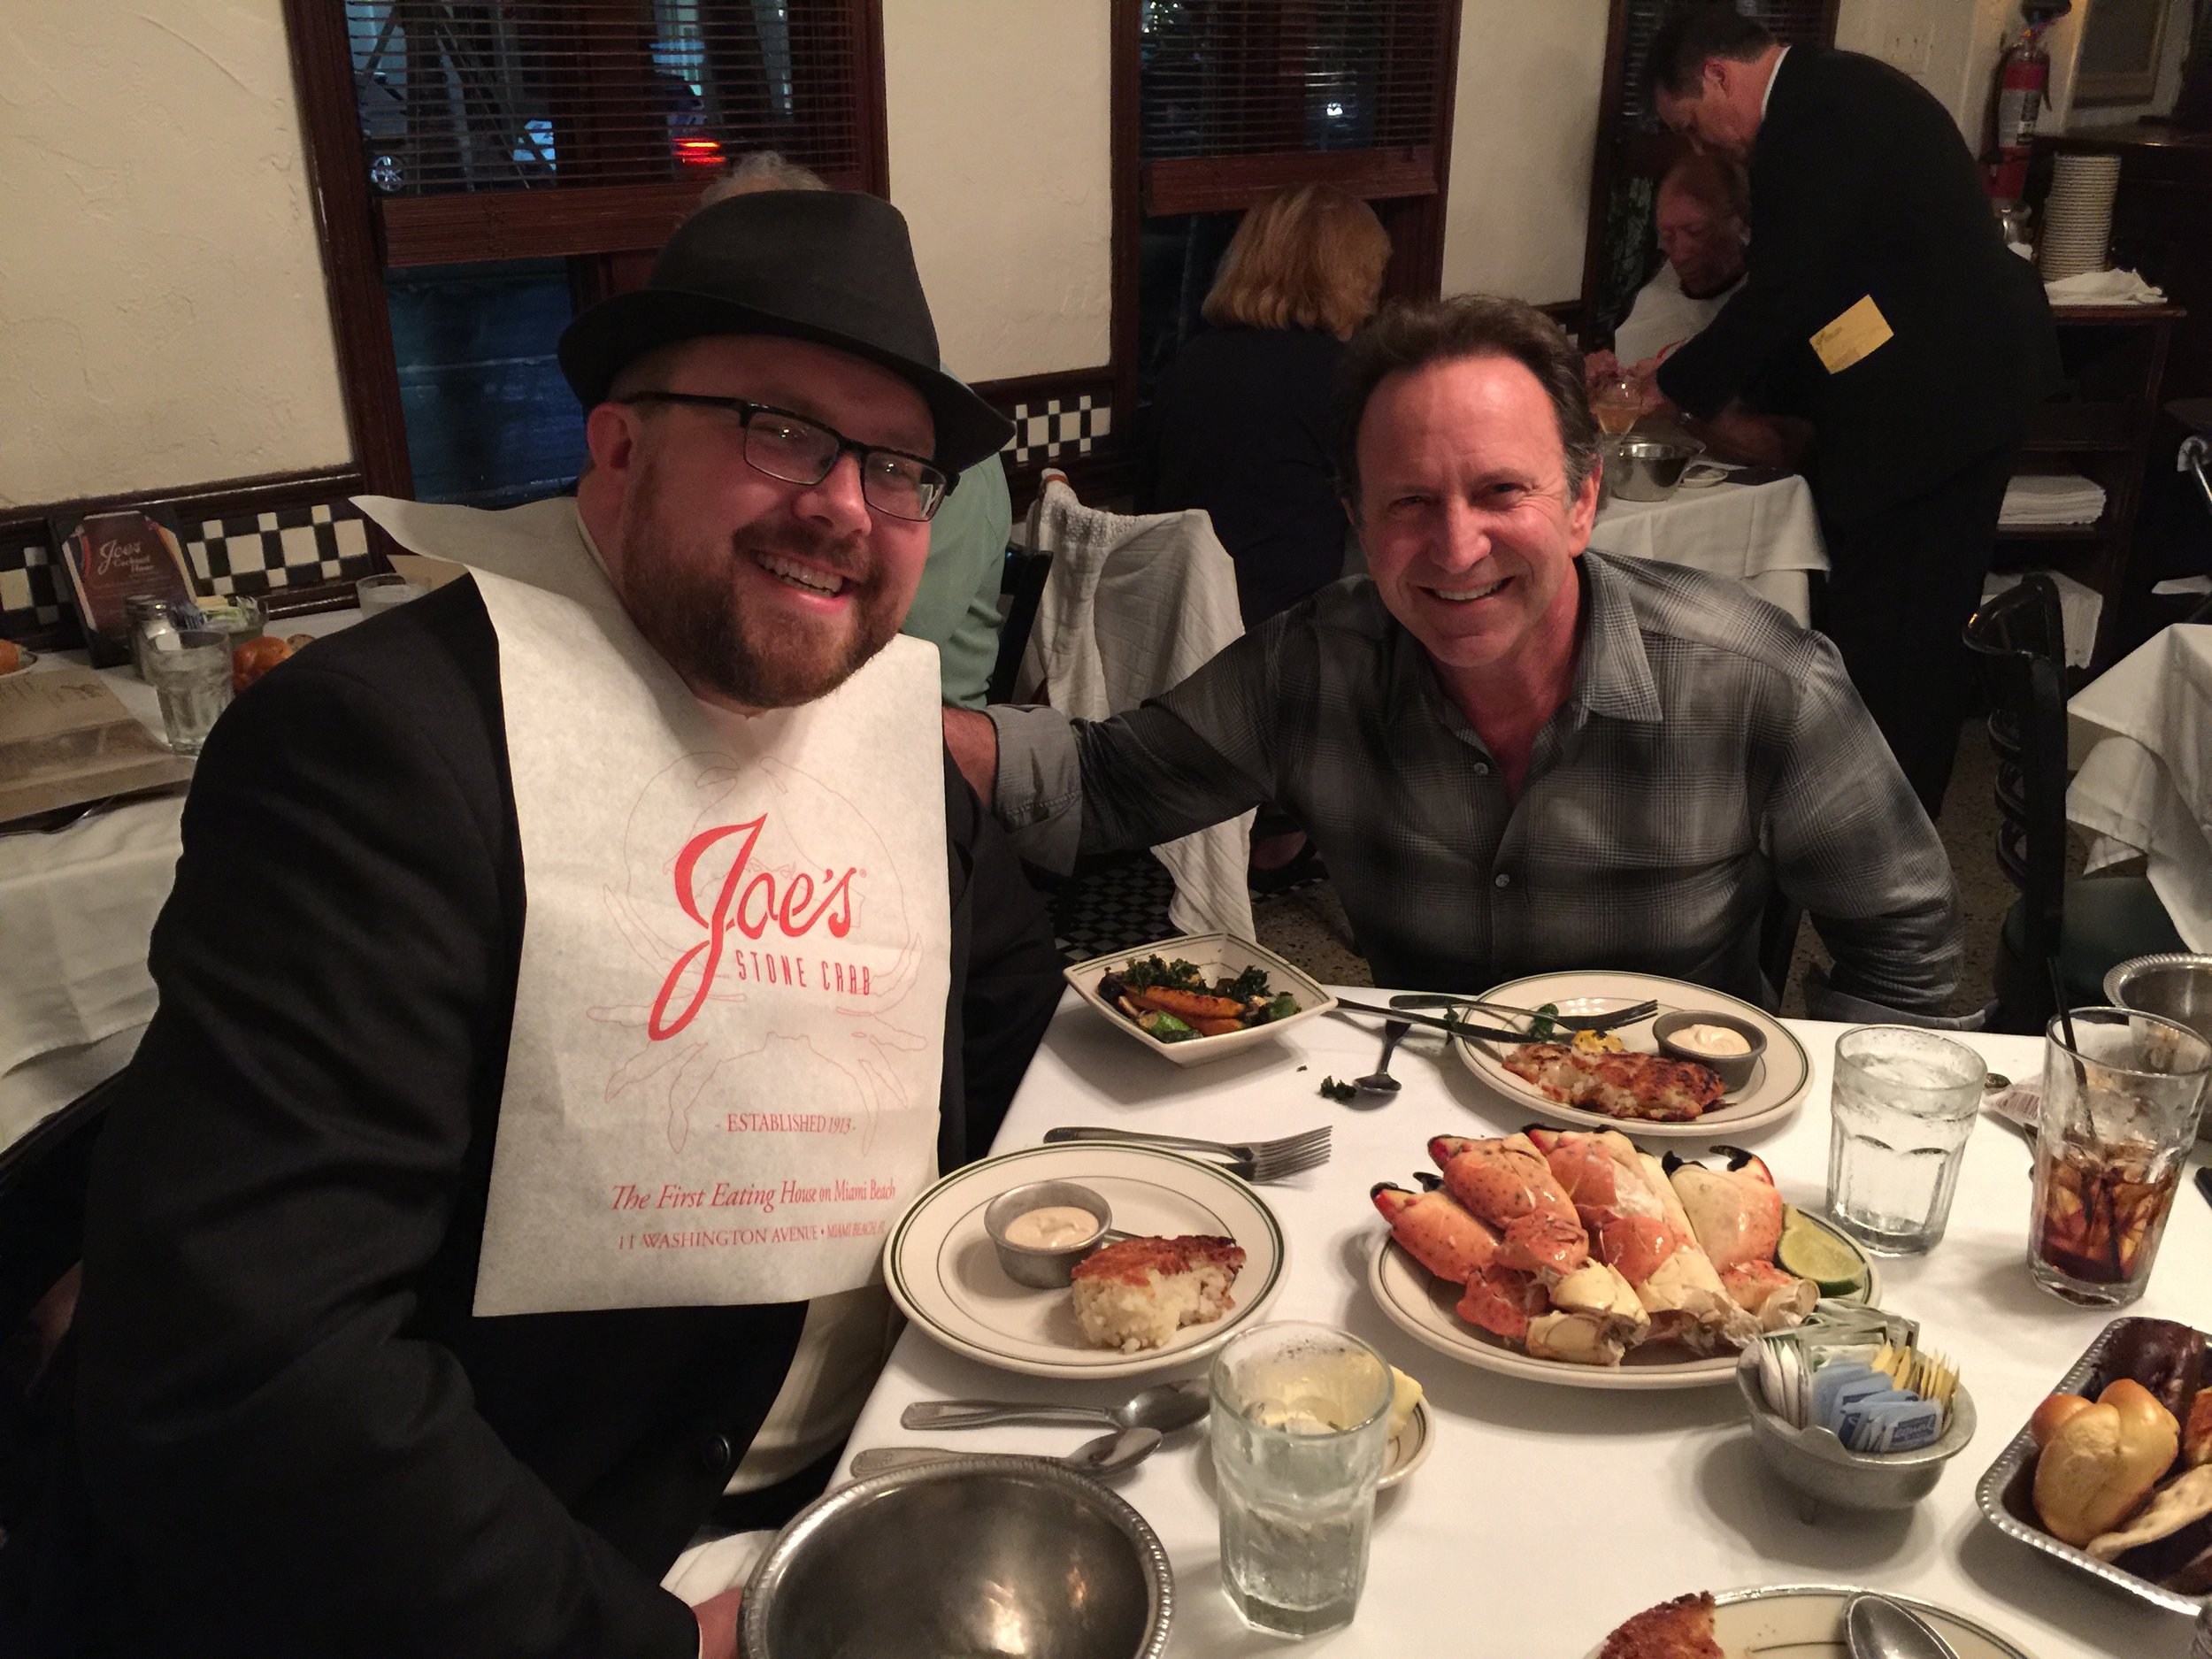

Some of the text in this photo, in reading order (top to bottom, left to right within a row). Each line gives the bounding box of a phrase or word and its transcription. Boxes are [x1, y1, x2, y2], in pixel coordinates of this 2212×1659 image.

[648, 813, 857, 1041] Joe's
[735, 949, 871, 995] STONE CRAB
[727, 1113, 852, 1134] ESTABLISHED 1913
[611, 1178, 896, 1213] The First Eating House on Miami Beach
[643, 1228, 768, 1249] WASHINGTON
[772, 1225, 818, 1242] AVENUE
